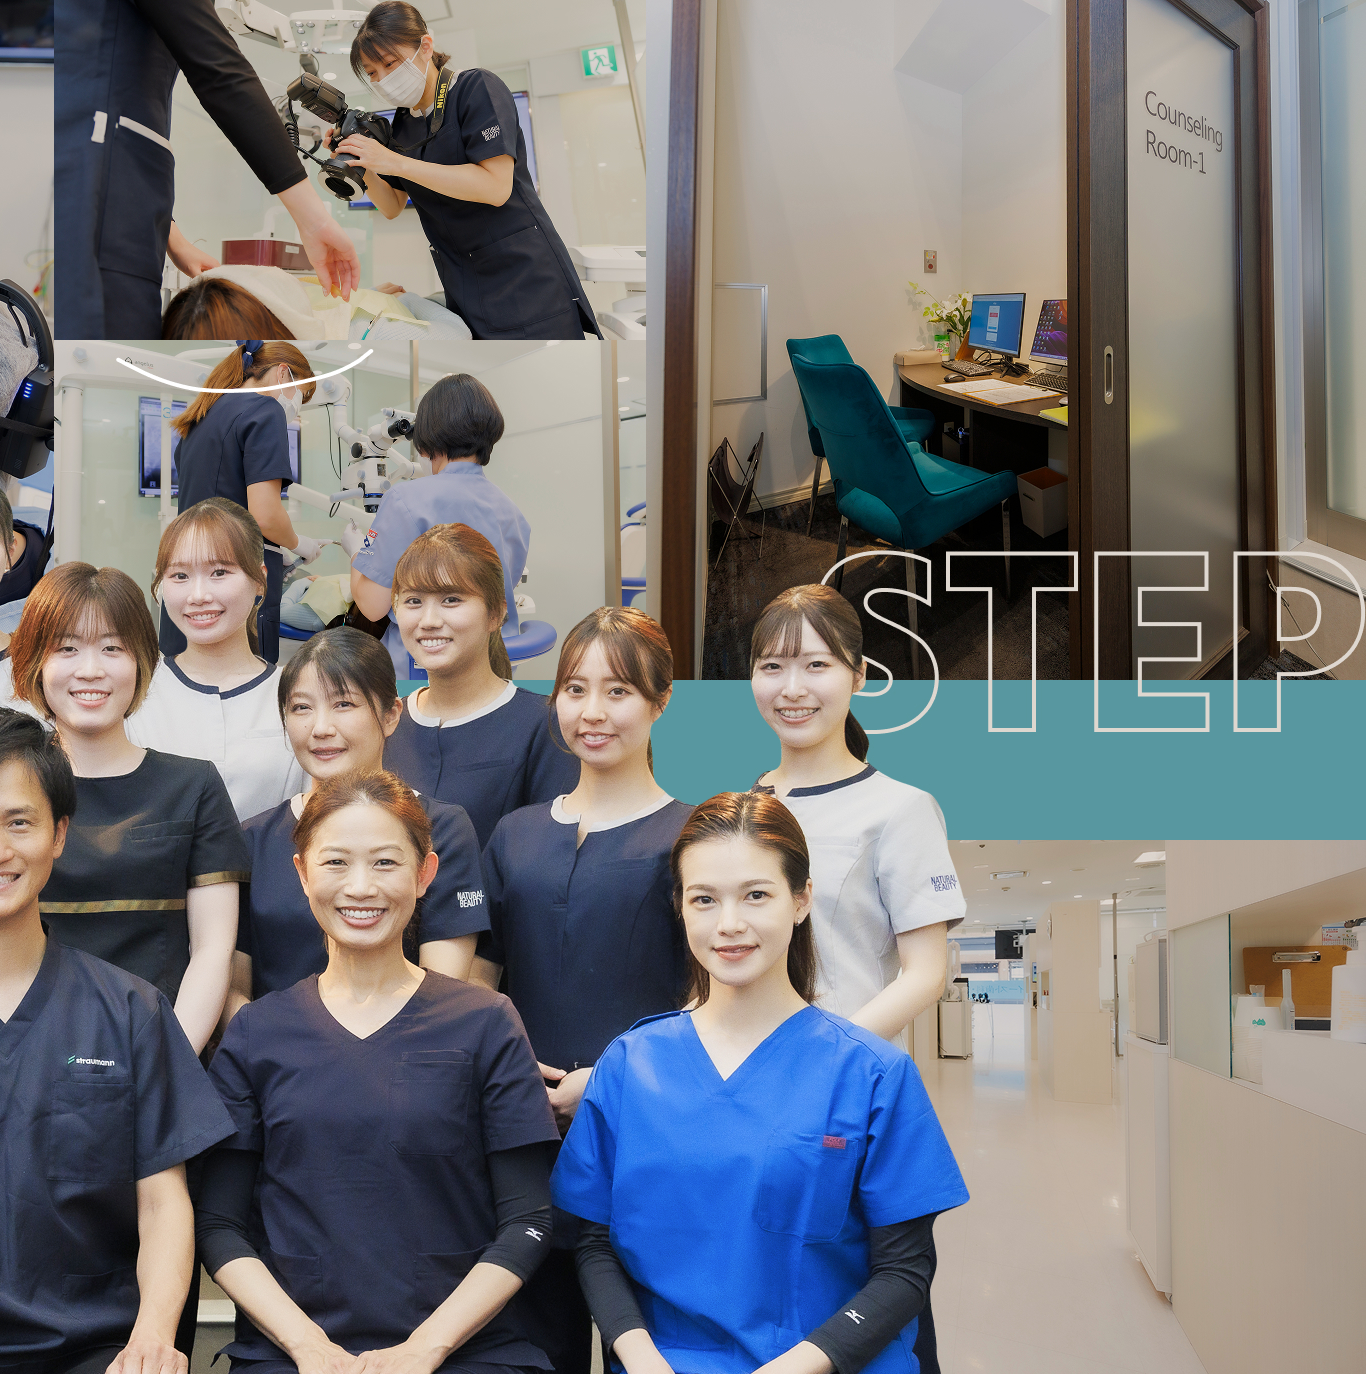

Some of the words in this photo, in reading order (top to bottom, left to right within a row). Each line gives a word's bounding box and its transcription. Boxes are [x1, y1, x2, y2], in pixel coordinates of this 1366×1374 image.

[436, 83, 447, 109] Nikon
[1145, 90, 1223, 153] Counseling
[1146, 129, 1207, 175] Room-1
[930, 874, 957, 886] NATURAL
[934, 882, 957, 892] BEAUTY
[457, 889, 484, 901] NATURAL
[459, 898, 483, 908] BEAUTY
[75, 1057, 115, 1067] straumann
